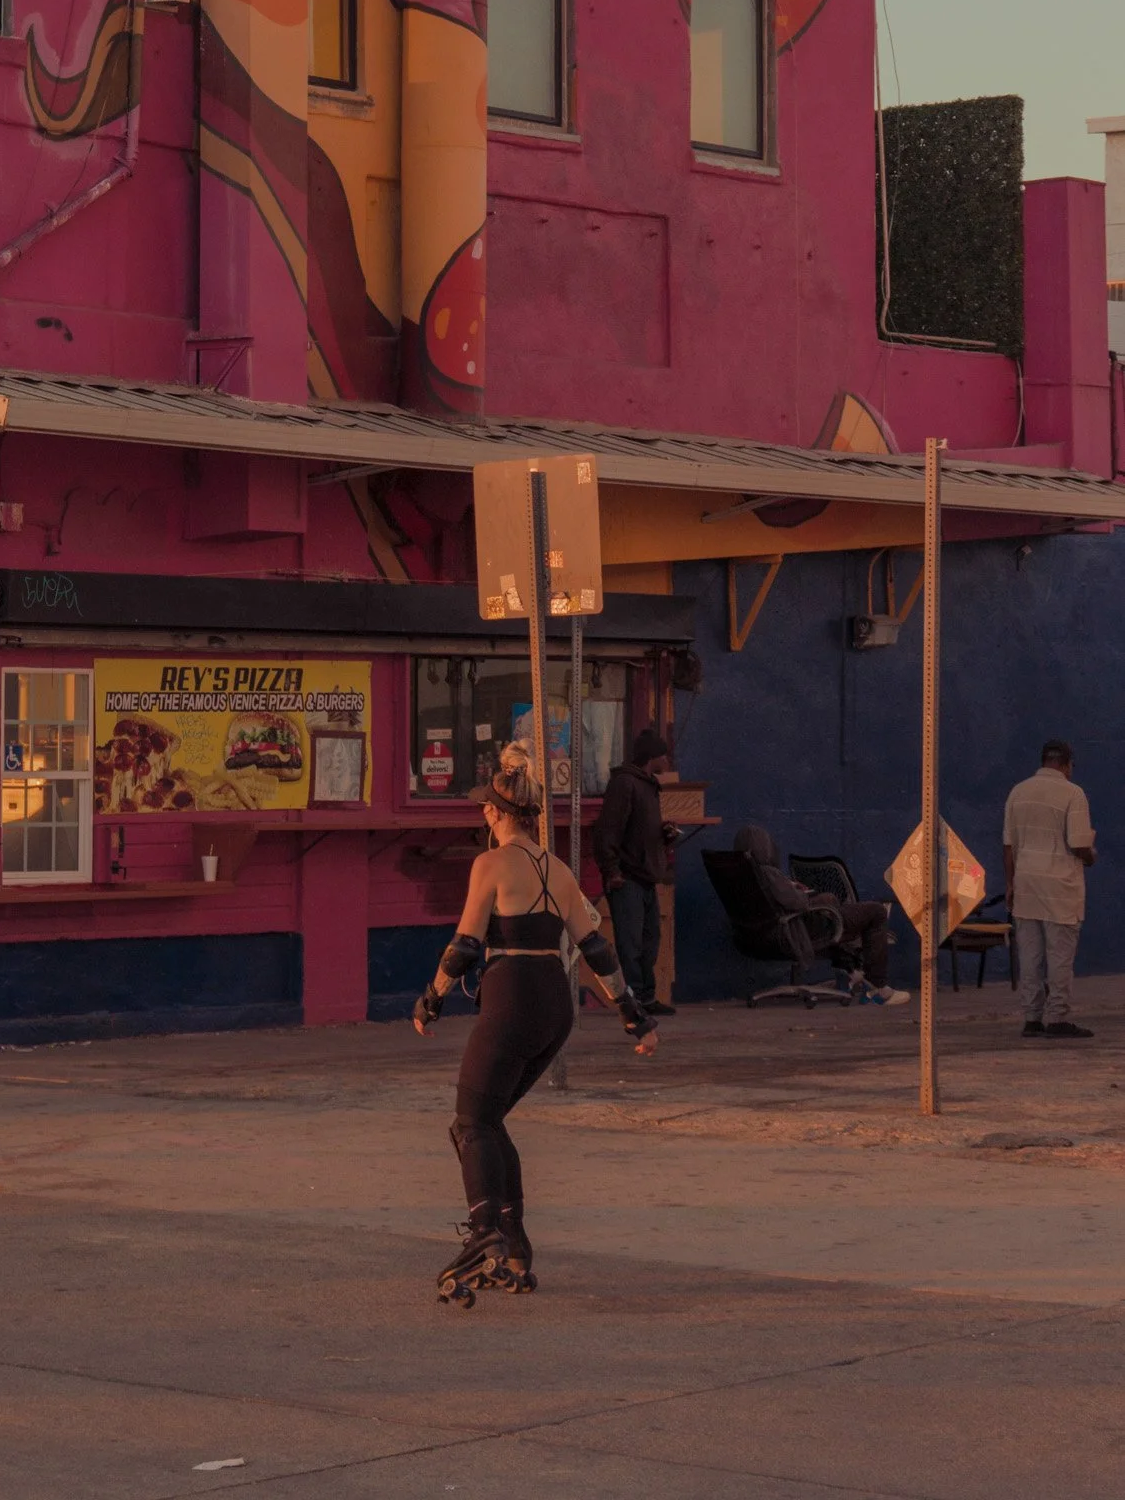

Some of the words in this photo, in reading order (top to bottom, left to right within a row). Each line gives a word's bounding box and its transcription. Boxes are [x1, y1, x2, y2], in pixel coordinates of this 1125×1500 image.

[160, 667, 229, 691] REY'S
[234, 667, 303, 692] PIZZA
[106, 692, 138, 712] HOME
[139, 692, 159, 712] OF
[158, 693, 180, 712] THE
[181, 693, 227, 712] FAMOUS
[229, 693, 267, 712] VENICE
[267, 693, 303, 712] PIZZA
[305, 693, 316, 712] &
[316, 693, 365, 712] BURGERS
